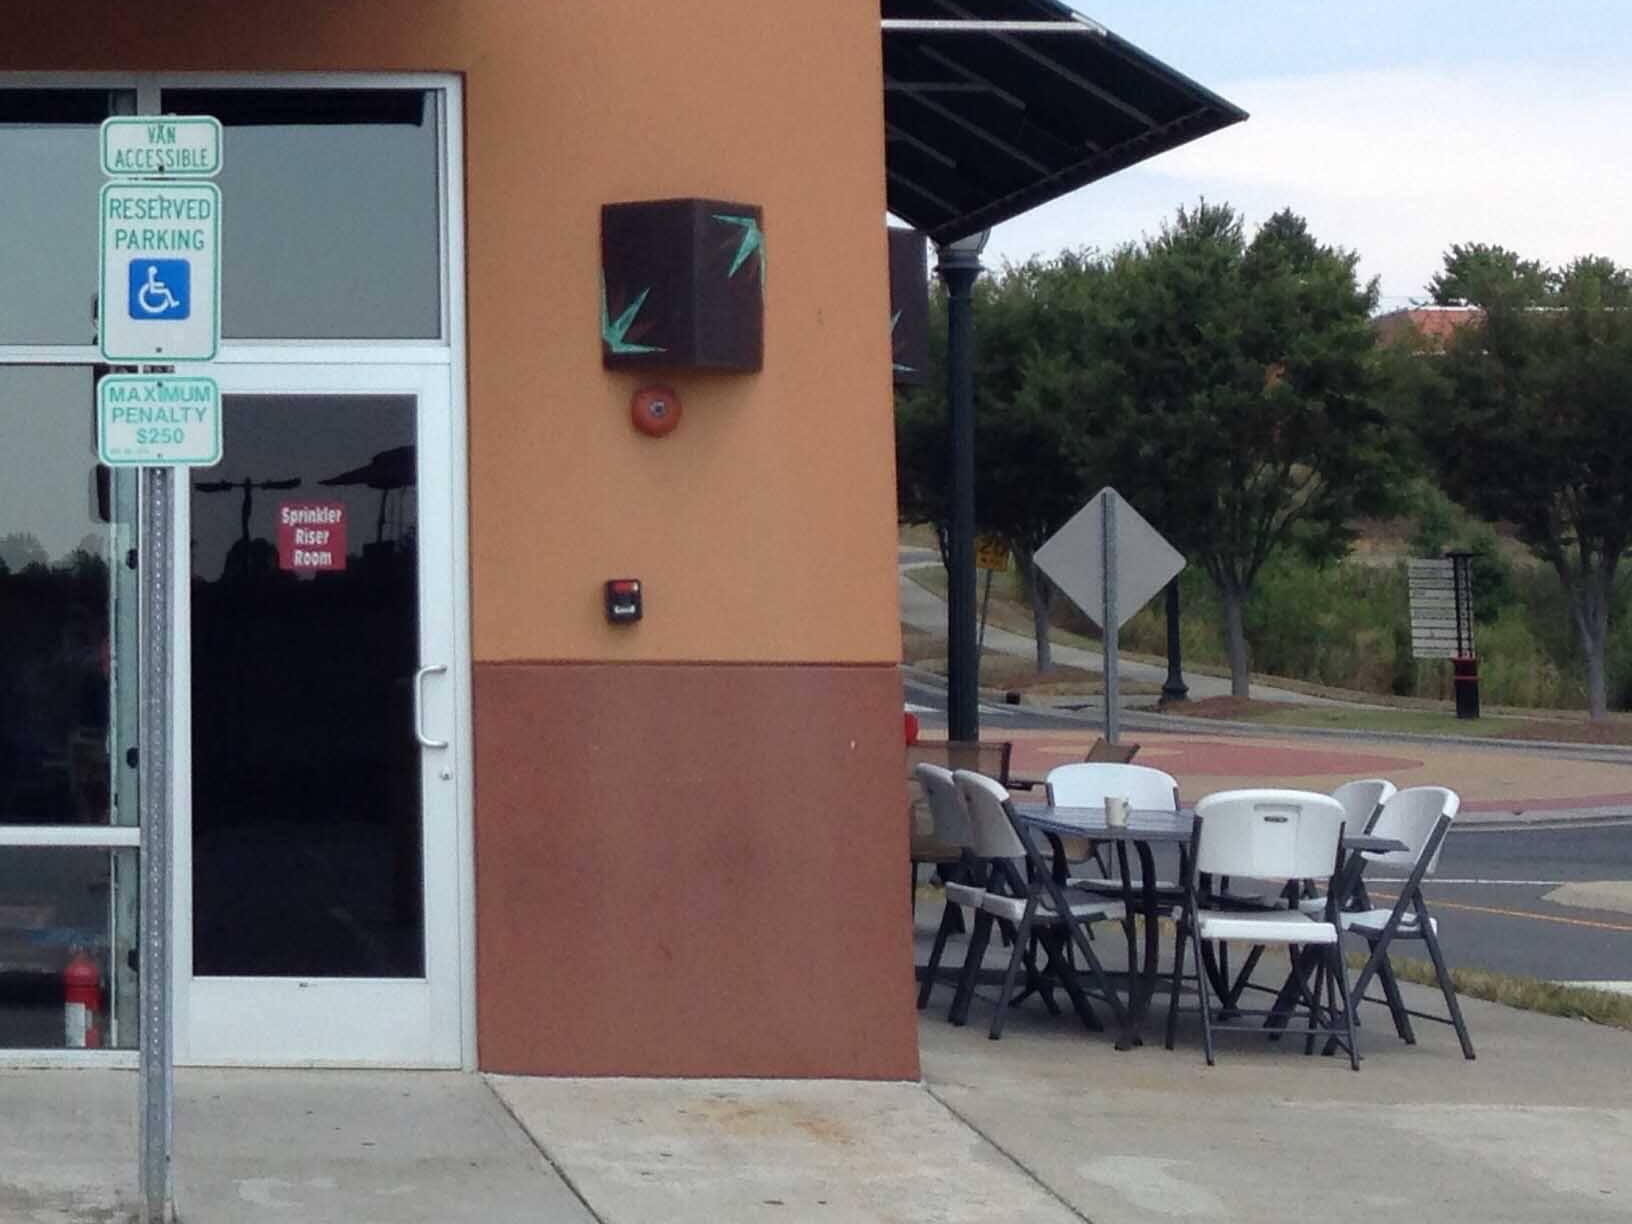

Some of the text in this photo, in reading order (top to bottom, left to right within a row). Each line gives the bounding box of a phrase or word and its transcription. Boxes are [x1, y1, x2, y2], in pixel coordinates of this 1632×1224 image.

[148, 126, 176, 144] VAN
[115, 148, 209, 168] ACCESSIBLE
[110, 198, 211, 220] RESERVED
[115, 228, 205, 251] PARKING
[110, 386, 210, 402] MAXIMUM
[112, 406, 207, 424] PENALTY
[282, 506, 343, 526] Sprinkler
[295, 528, 330, 545] Riser
[294, 549, 332, 566] Room
